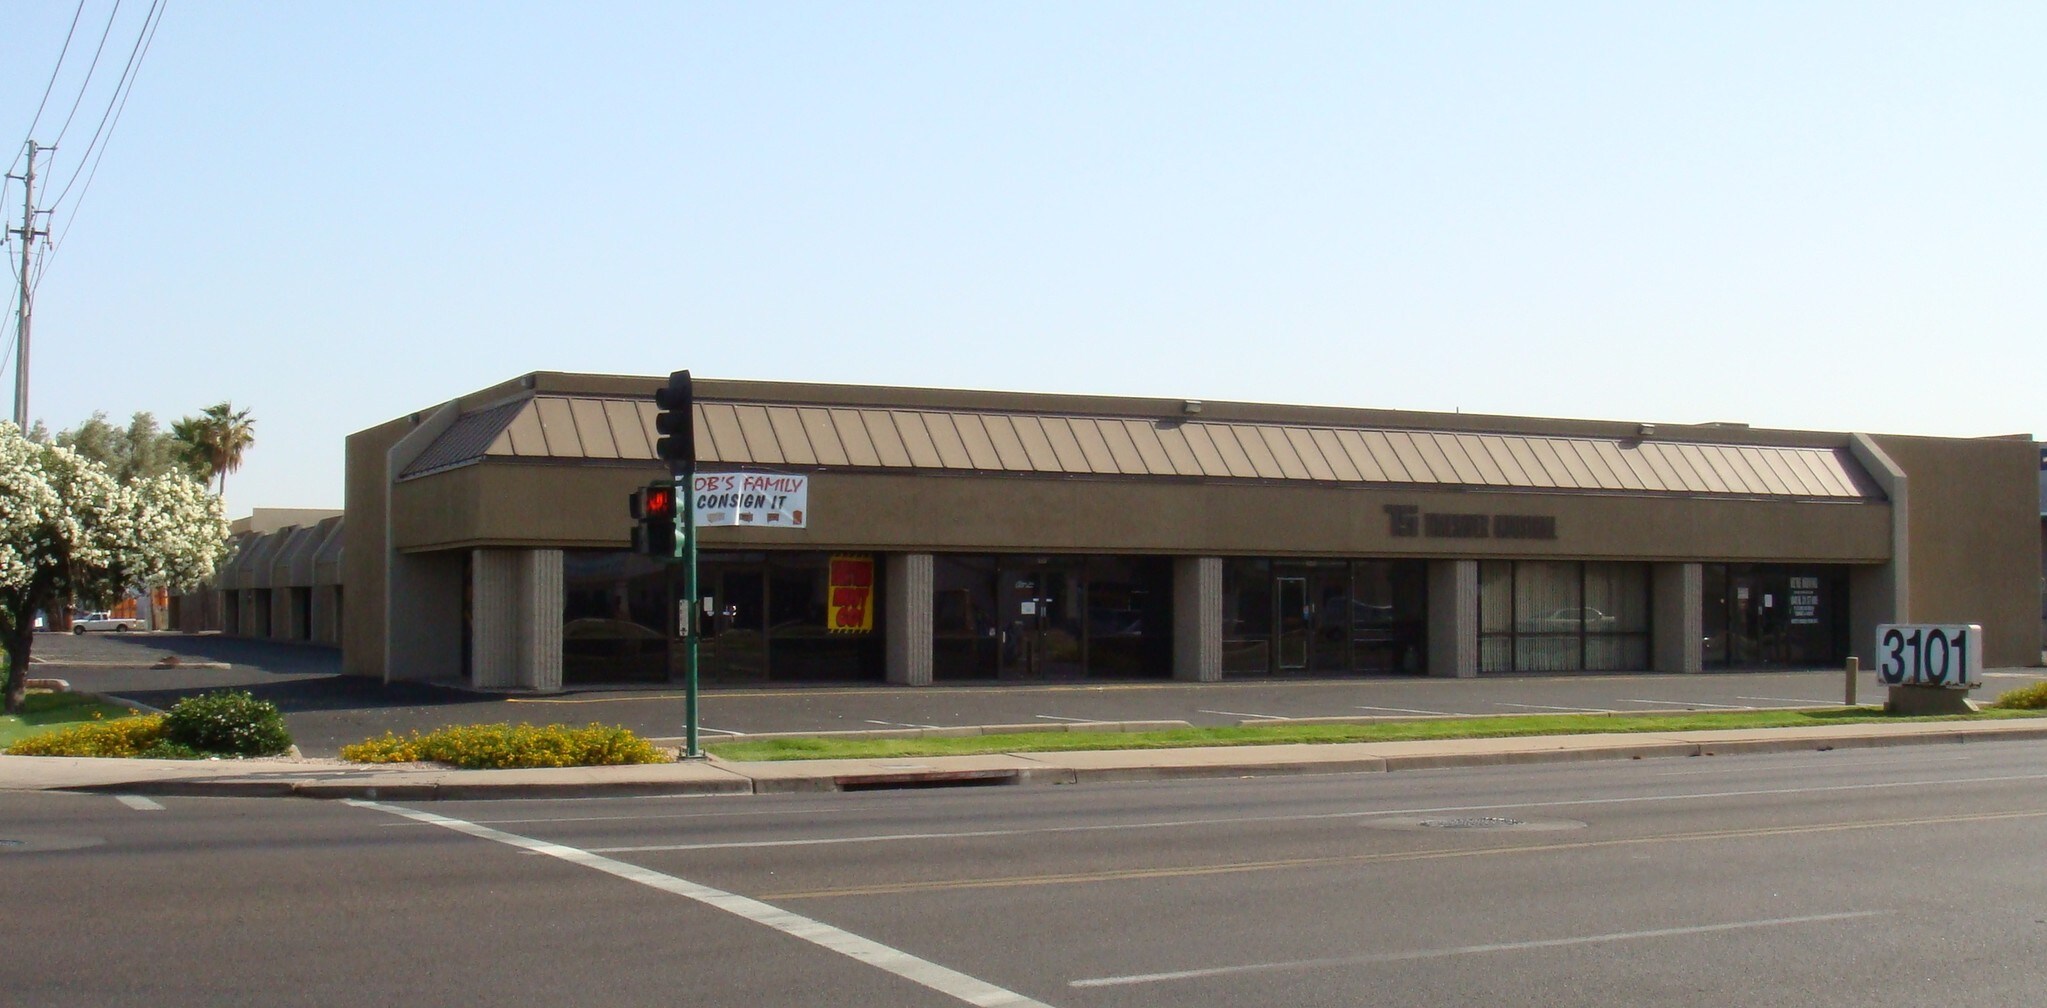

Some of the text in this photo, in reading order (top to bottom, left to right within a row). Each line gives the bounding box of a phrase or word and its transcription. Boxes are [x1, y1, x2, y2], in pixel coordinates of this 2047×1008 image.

[694, 476, 804, 492] OB'S FAMILY
[697, 493, 787, 509] CONSIGN IT
[1882, 628, 1966, 685] 3101
